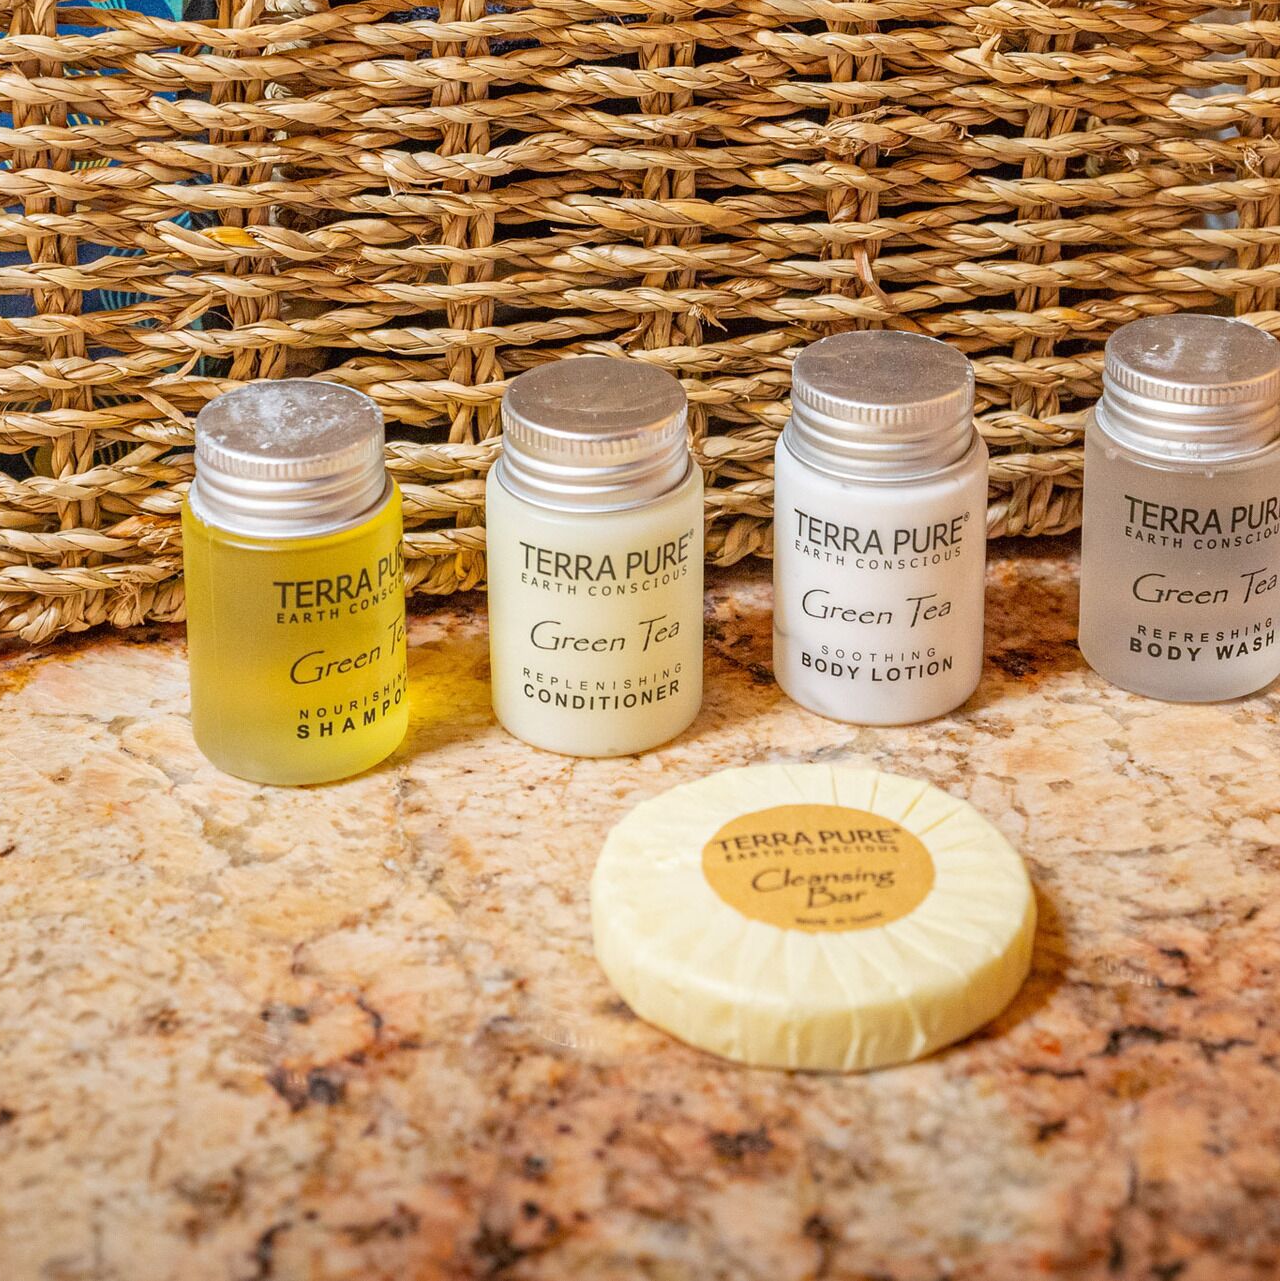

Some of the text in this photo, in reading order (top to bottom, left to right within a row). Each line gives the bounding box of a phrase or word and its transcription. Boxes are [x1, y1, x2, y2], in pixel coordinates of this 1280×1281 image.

[1124, 494, 1222, 535] TERRA
[794, 508, 883, 555] TERRA
[1125, 526, 1182, 549] EARTH
[519, 541, 616, 581] TERRA
[795, 539, 961, 570] EARTH CONSCIOUS
[273, 539, 404, 609] TERRA PUR
[521, 564, 688, 597] EARTH CONSCIOUS
[1132, 567, 1278, 604] Green Tea
[276, 607, 339, 624] EARTH
[802, 589, 952, 628] Green Tea
[530, 615, 680, 652] Green Tea
[1130, 629, 1275, 662] BODY WASH
[1137, 617, 1272, 643] REFRESHING
[290, 612, 405, 685] Green Te
[821, 644, 936, 663] SOOTHING
[523, 663, 682, 690] REPLENISHING
[801, 652, 953, 682] BODY LOTION
[524, 680, 680, 711] CONDITIONER
[716, 831, 813, 853] TERRA
[726, 845, 900, 863] EARTH CONSCIOUS
[751, 867, 895, 893] Cleansing
[806, 886, 868, 909] Bar
